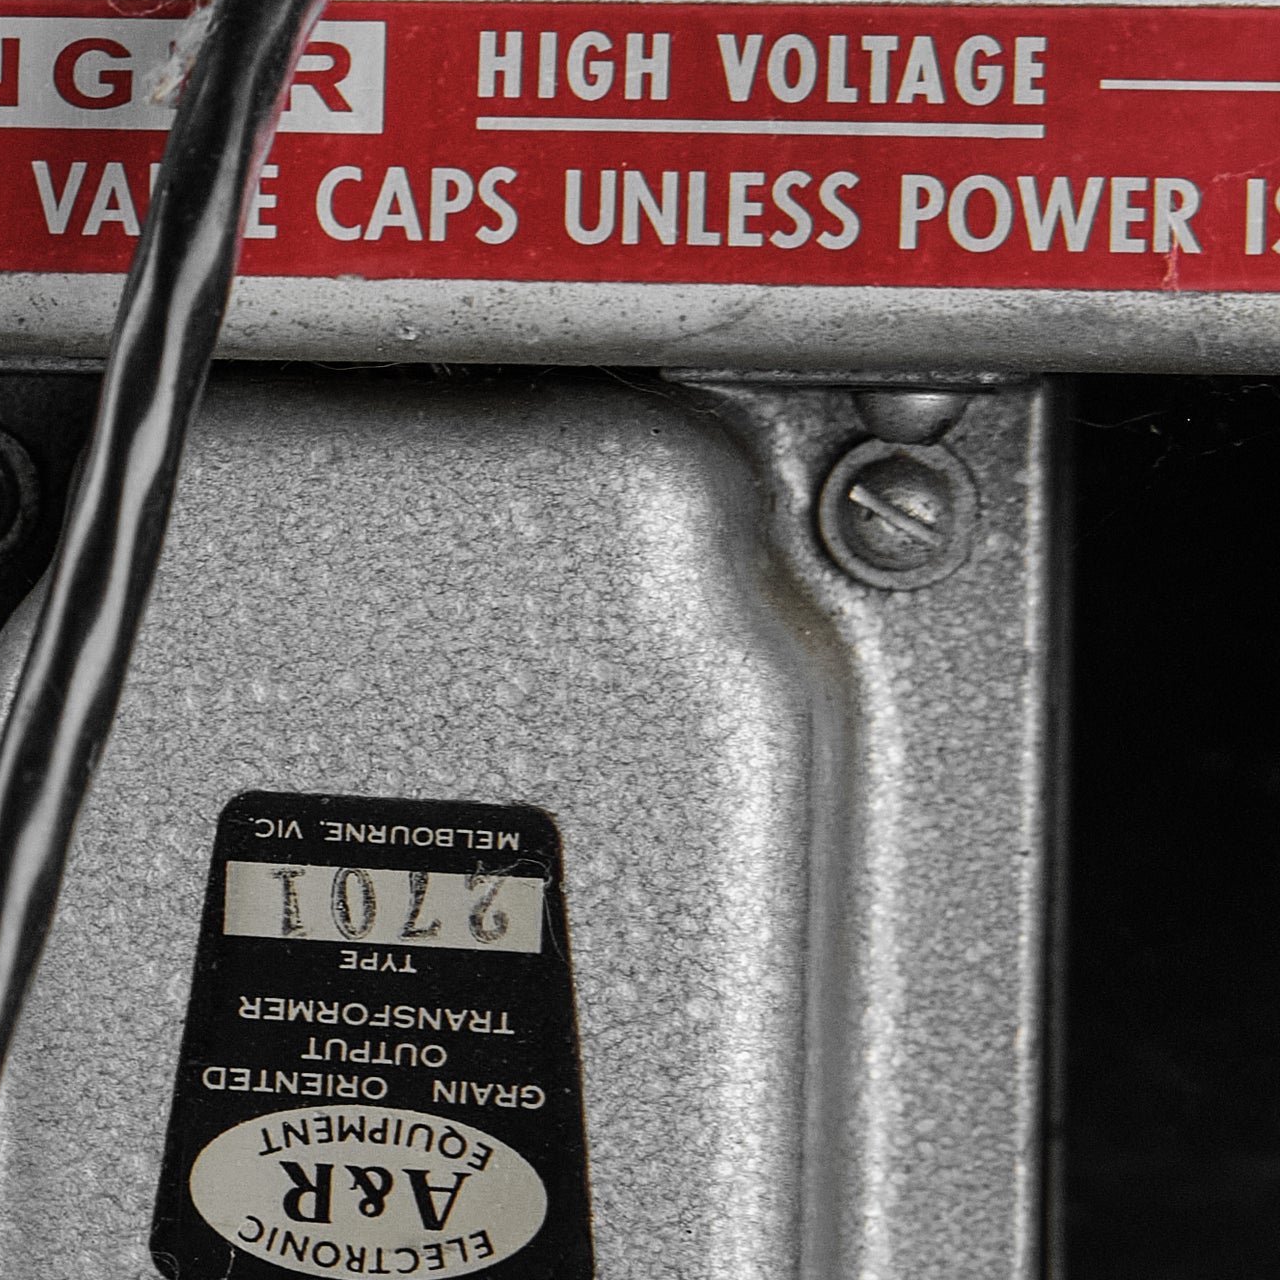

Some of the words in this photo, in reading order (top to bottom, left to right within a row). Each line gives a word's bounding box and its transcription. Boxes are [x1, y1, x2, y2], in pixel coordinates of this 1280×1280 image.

[477, 30, 671, 102] HIGH
[717, 33, 1047, 106] VOLTAGE
[31, 160, 279, 240] VAE
[314, 165, 519, 245] CAPS
[564, 169, 861, 250] UNLESS
[898, 174, 1203, 255] POWER
[1245, 178, 1280, 257] I
[247, 816, 304, 841] VIC.
[270, 865, 510, 945] 2701
[338, 949, 418, 974] TYPE
[238, 995, 516, 1035] TRANSFORMER
[301, 1036, 448, 1069] OUTPUT
[202, 1065, 388, 1099] ORIENTED
[432, 1078, 546, 1111] GRAIN
[258, 1114, 495, 1173] EQUIPMENT
[279, 1160, 473, 1232] A&R
[237, 1214, 496, 1275] ELECTRONIC
